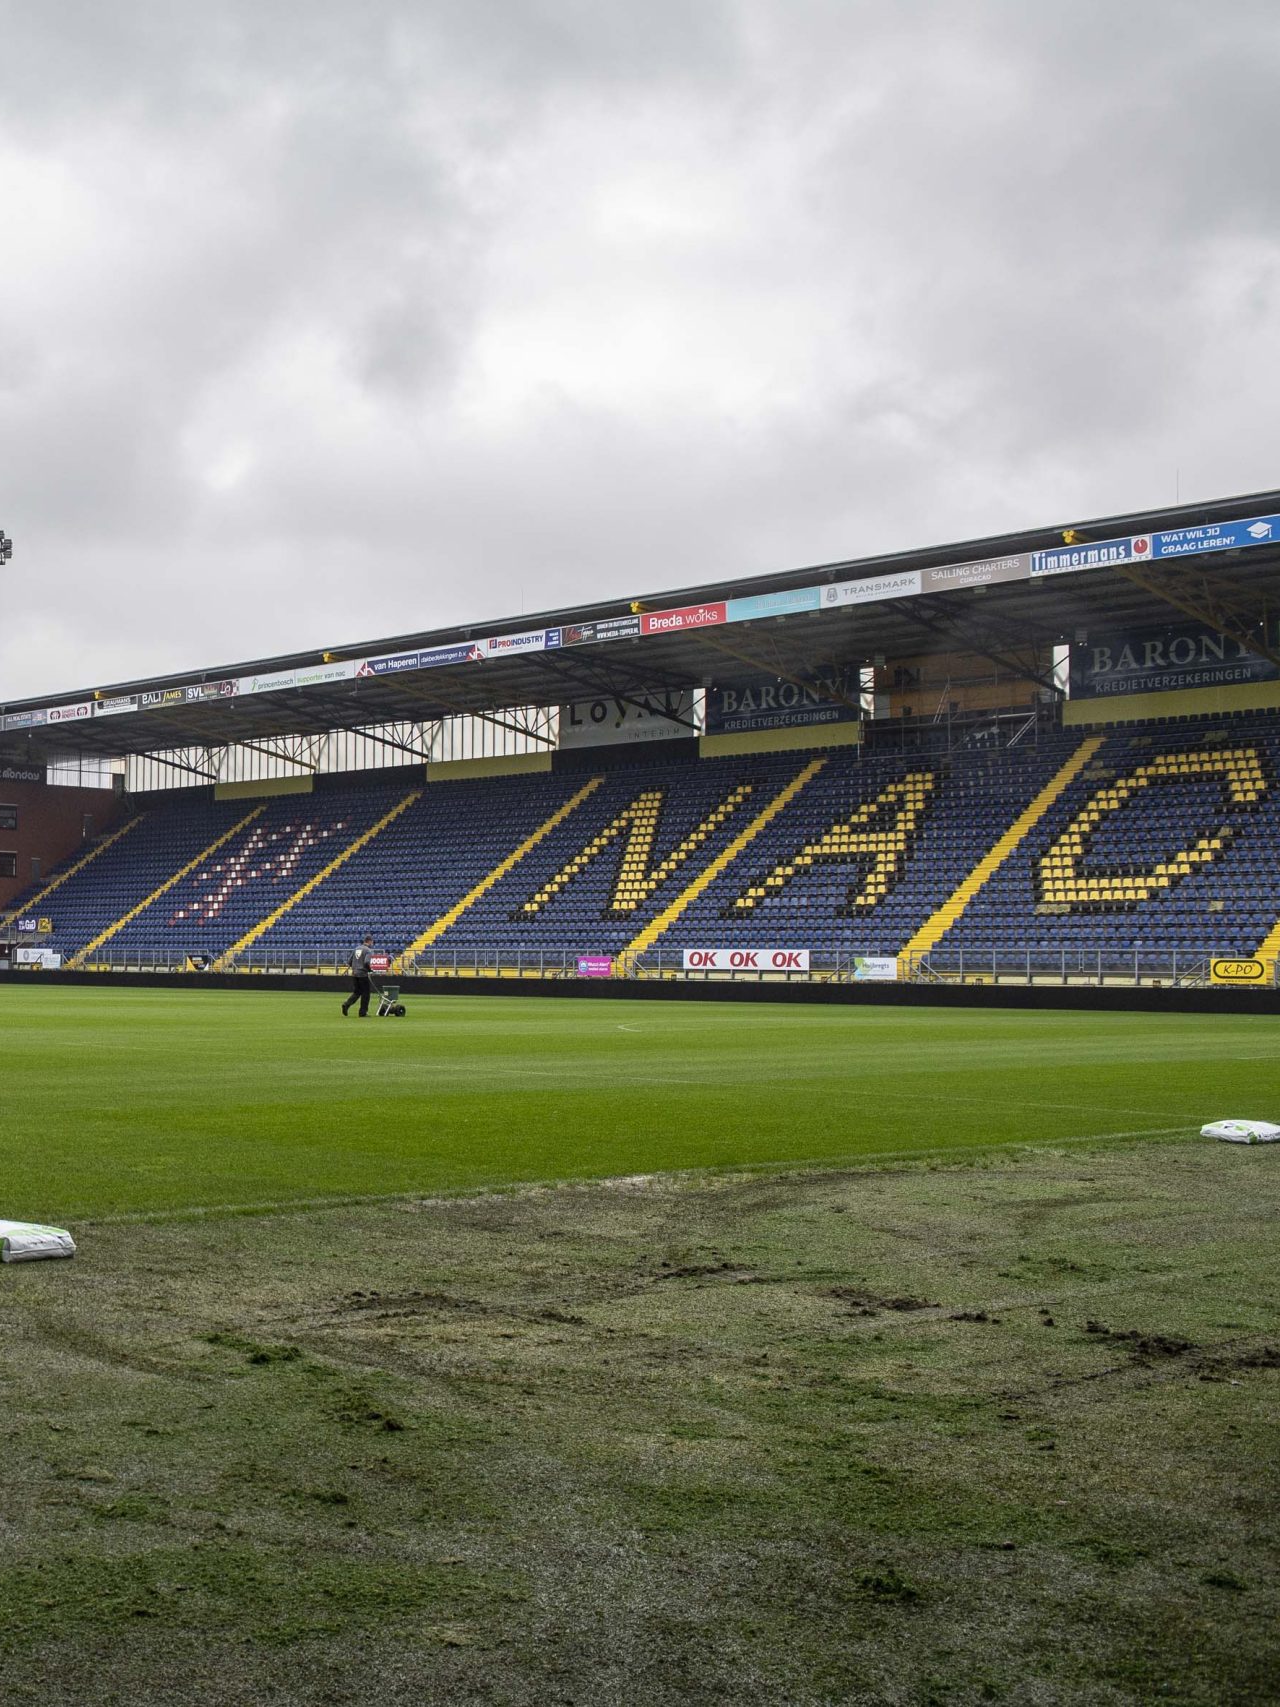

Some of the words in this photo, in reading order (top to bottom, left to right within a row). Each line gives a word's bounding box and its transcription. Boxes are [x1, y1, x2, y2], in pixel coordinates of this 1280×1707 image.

[1160, 532, 1183, 543] WAT
[1185, 530, 1205, 540] WIL
[1206, 527, 1220, 537] JIJ
[1161, 542, 1197, 554] GRAAG
[1198, 536, 1236, 550] LEREN?
[1033, 545, 1126, 571] Timmermans
[931, 567, 970, 580] SAILING
[972, 558, 1020, 574] CHARTERS
[842, 577, 916, 595] TRANSMARK
[649, 609, 718, 630] Breda.works
[497, 635, 544, 648] PROINDUSTRY
[1091, 629, 1255, 674] BARONY
[374, 662, 386, 671] van
[387, 657, 418, 670] Haperen
[297, 673, 323, 685] supporter
[1094, 667, 1253, 694] KREDIETVERZEKERINGEN
[187, 686, 204, 698] SVL
[721, 677, 844, 714] BARONY
[723, 709, 840, 730] KREDIETVERZEKERINGEN
[627, 729, 681, 741] INTERIM
[688, 951, 717, 968] OK
[729, 951, 759, 968] OK
[771, 952, 802, 969] OK
